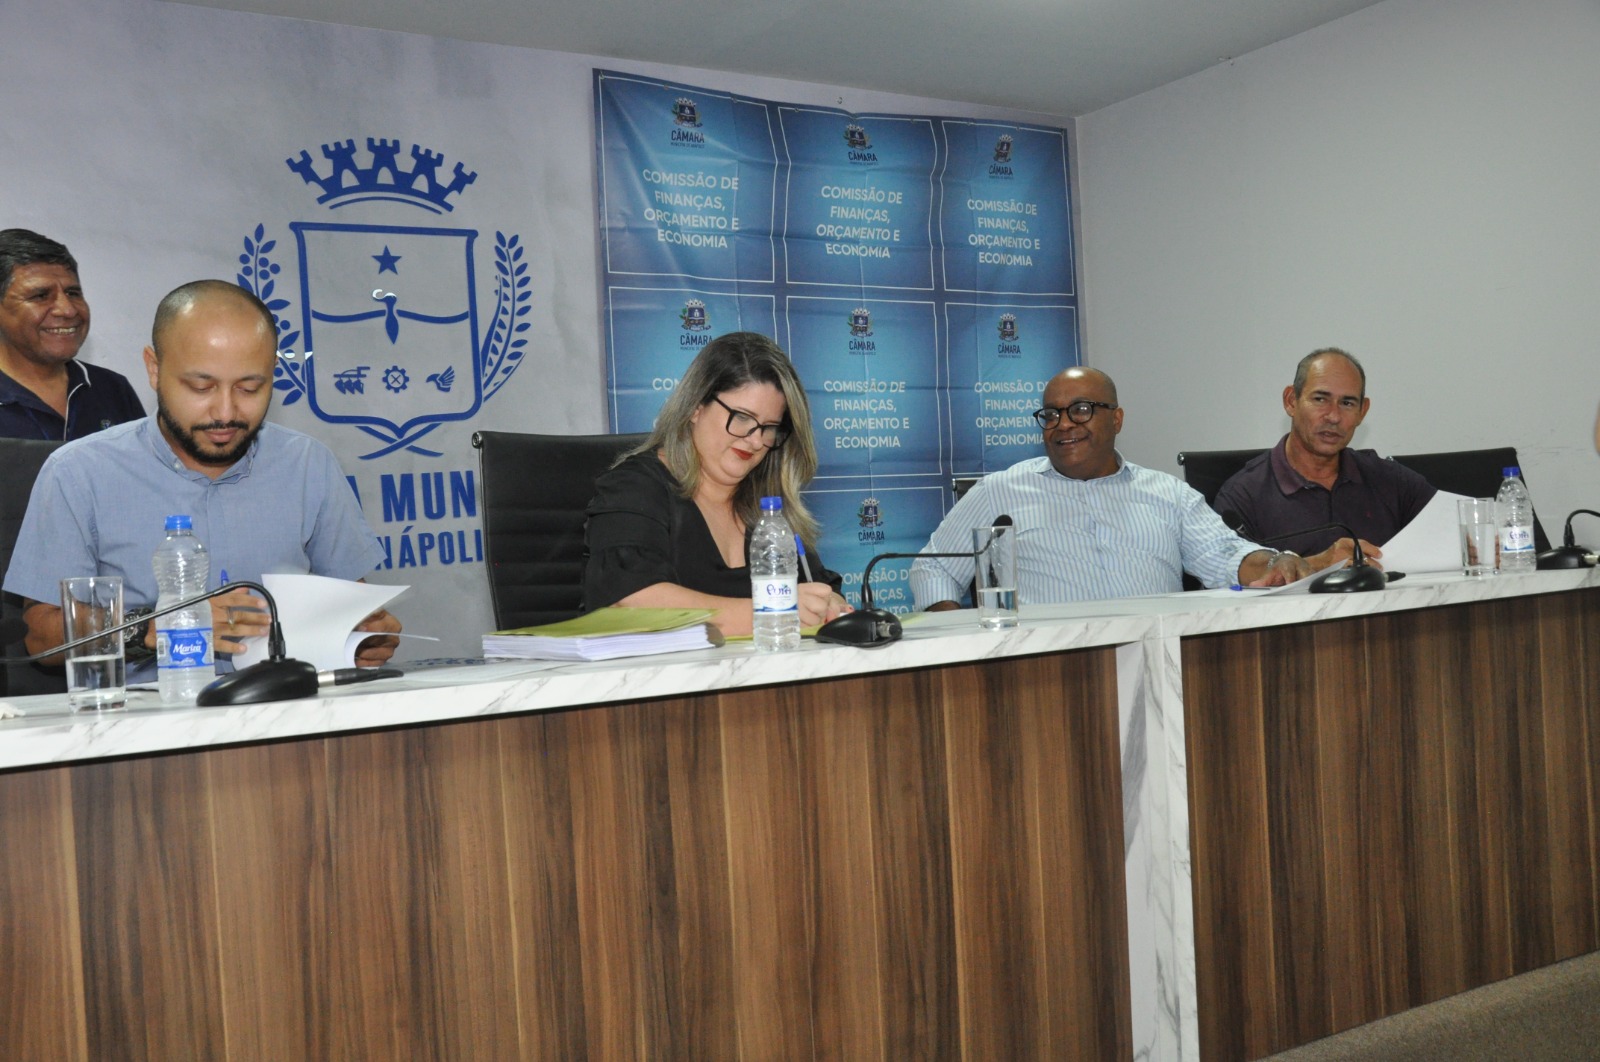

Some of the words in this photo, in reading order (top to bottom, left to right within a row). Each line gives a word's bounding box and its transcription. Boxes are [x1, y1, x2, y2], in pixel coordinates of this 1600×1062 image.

[671, 128, 705, 143] CÂMARA
[642, 168, 717, 189] COMISSÃO
[721, 176, 739, 190] DE
[654, 190, 726, 211] FINANÇAS,
[821, 185, 885, 204] COMISSÃO
[888, 190, 903, 204] DE
[830, 205, 890, 224] FINANÇAS,
[967, 199, 1024, 214] COMISSÃO
[1025, 203, 1037, 215] DE
[644, 208, 727, 229] ORÇAMENTO
[731, 218, 740, 230] E
[978, 217, 1029, 233] FINANÇAS,
[657, 229, 728, 248] ECONOMIA
[816, 224, 891, 243] ORÇAMENTO
[893, 230, 900, 241] E
[968, 234, 1032, 250] ORÇAMENTO
[1034, 238, 1040, 250] E
[826, 243, 890, 258] ECONOMIA
[978, 252, 1033, 267] ECONOMIA
[848, 338, 876, 351] CÂMARA
[824, 378, 887, 393] COMISSÃO
[890, 381, 906, 393] DE
[974, 379, 1034, 393] COMISSÃO
[834, 399, 897, 414] FINANÇAS,
[824, 416, 899, 432] ORÇAMENTO
[903, 417, 910, 429] E
[976, 416, 1037, 430] ORÇAMENT
[835, 436, 901, 448] ECONOMIA
